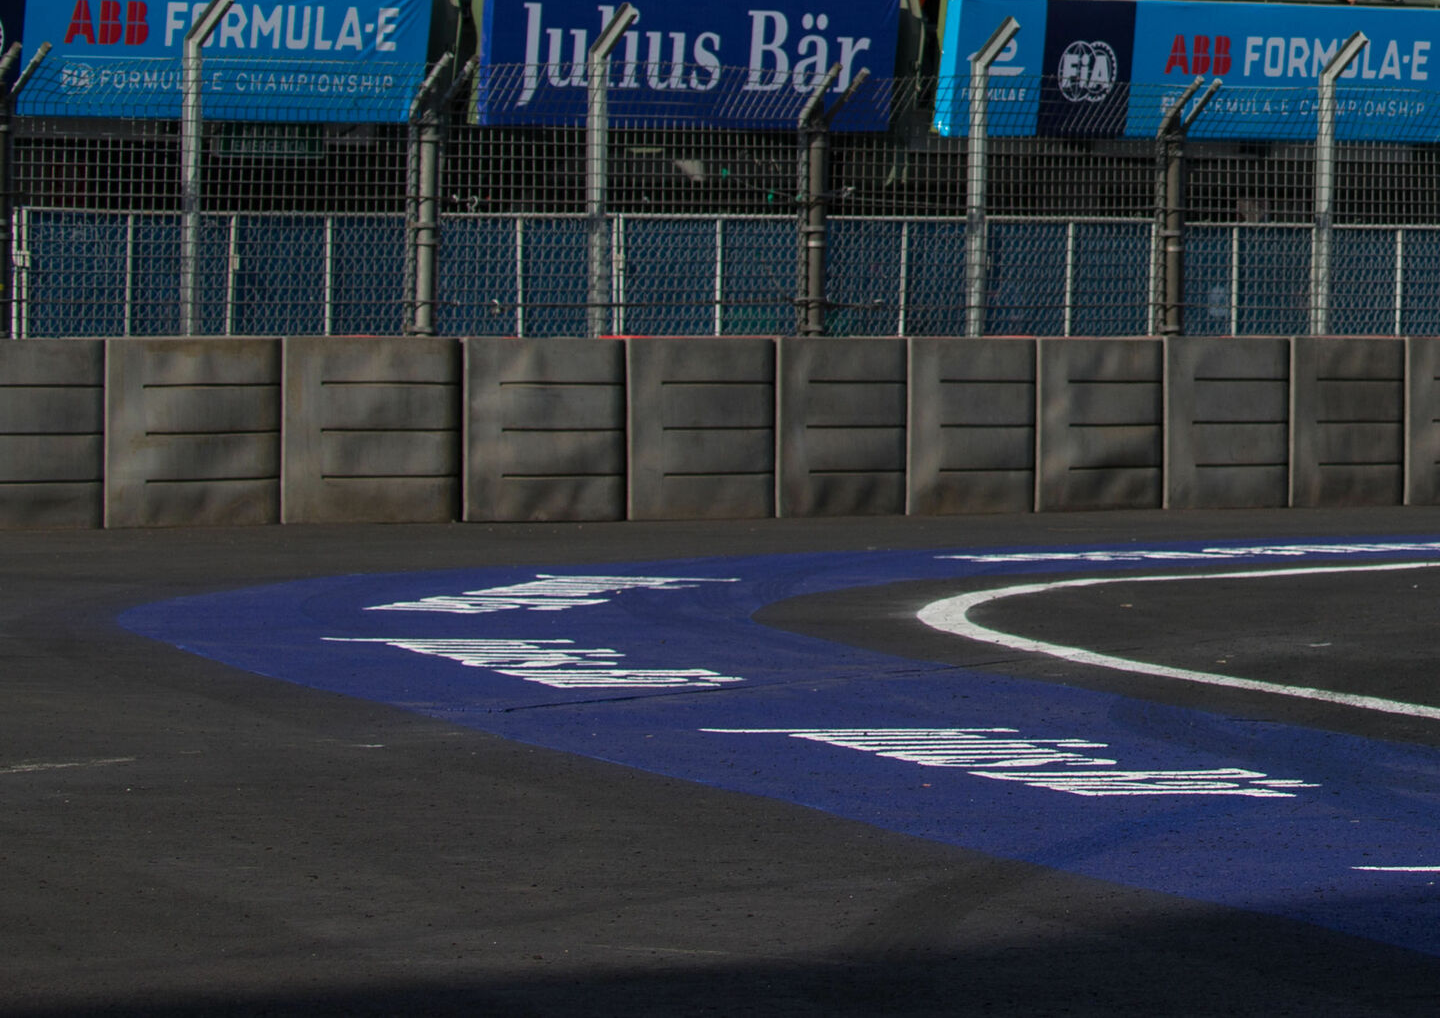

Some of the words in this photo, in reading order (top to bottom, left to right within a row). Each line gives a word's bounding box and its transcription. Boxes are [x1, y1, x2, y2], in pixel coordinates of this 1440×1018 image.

[64, 0, 149, 45] ABB
[743, 10, 871, 93] Bär
[1164, 35, 1232, 76] ABB
[100, 71, 222, 89] FORMUL-E
[236, 74, 394, 93] CHAMPIONSHIP
[1300, 98, 1425, 117] CHMPIONSHIP
